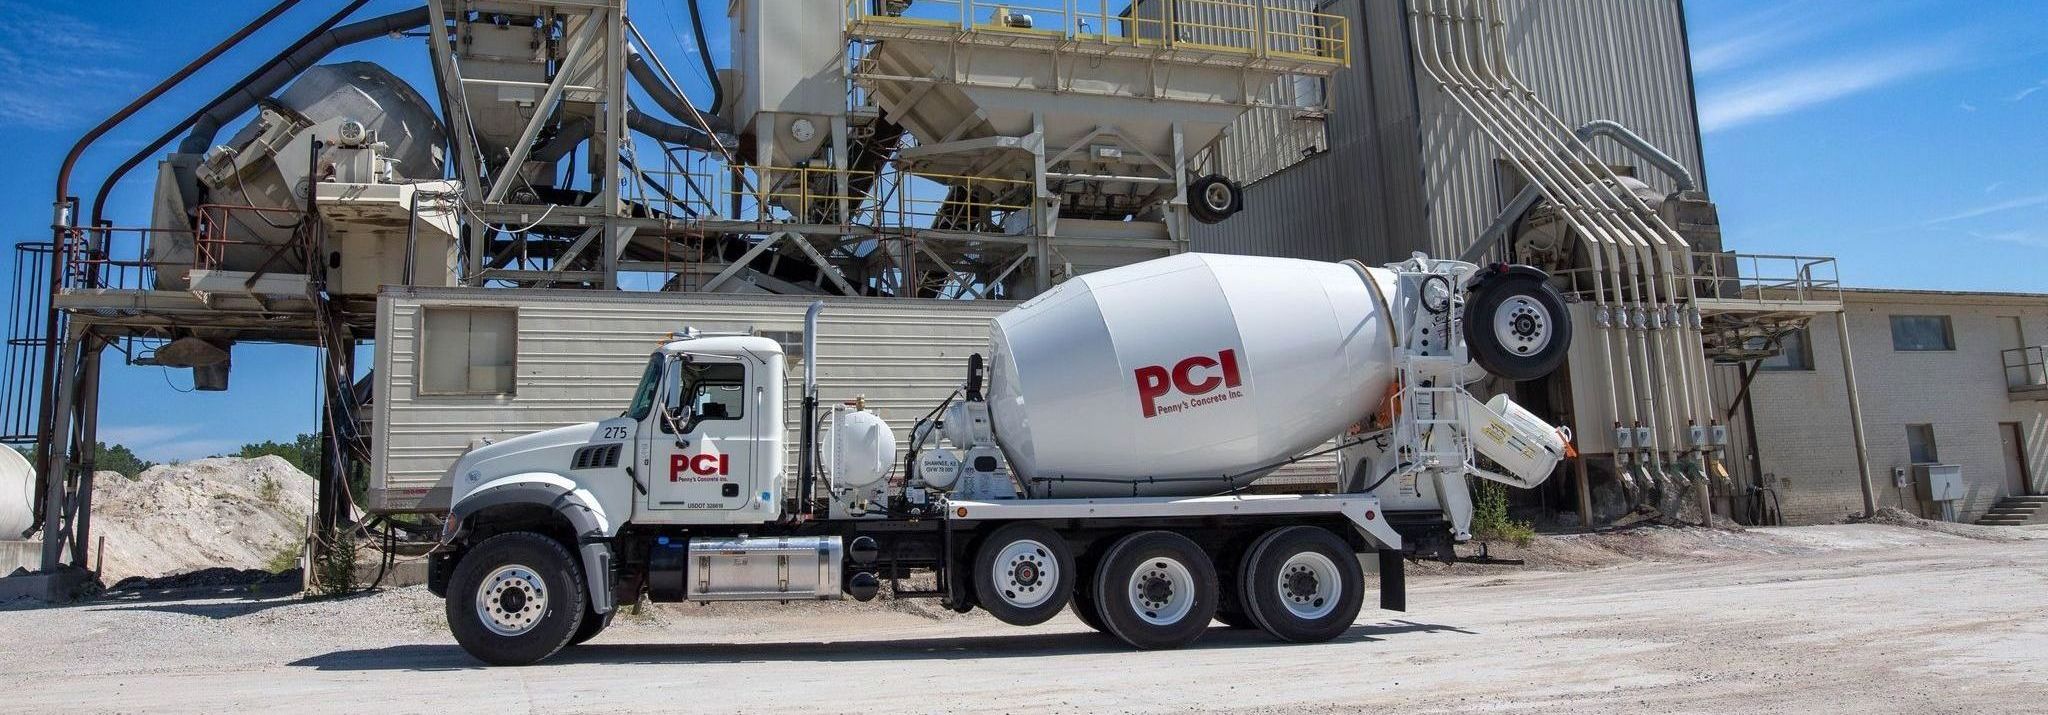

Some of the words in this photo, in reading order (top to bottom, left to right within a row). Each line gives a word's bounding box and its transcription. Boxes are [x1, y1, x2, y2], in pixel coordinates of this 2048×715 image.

[1134, 349, 1242, 418] PCI
[1157, 401, 1189, 414] Penny's
[1191, 394, 1227, 407] Concrete
[1229, 390, 1243, 399] Inc.
[604, 426, 627, 439] 275
[670, 454, 729, 482] PCI
